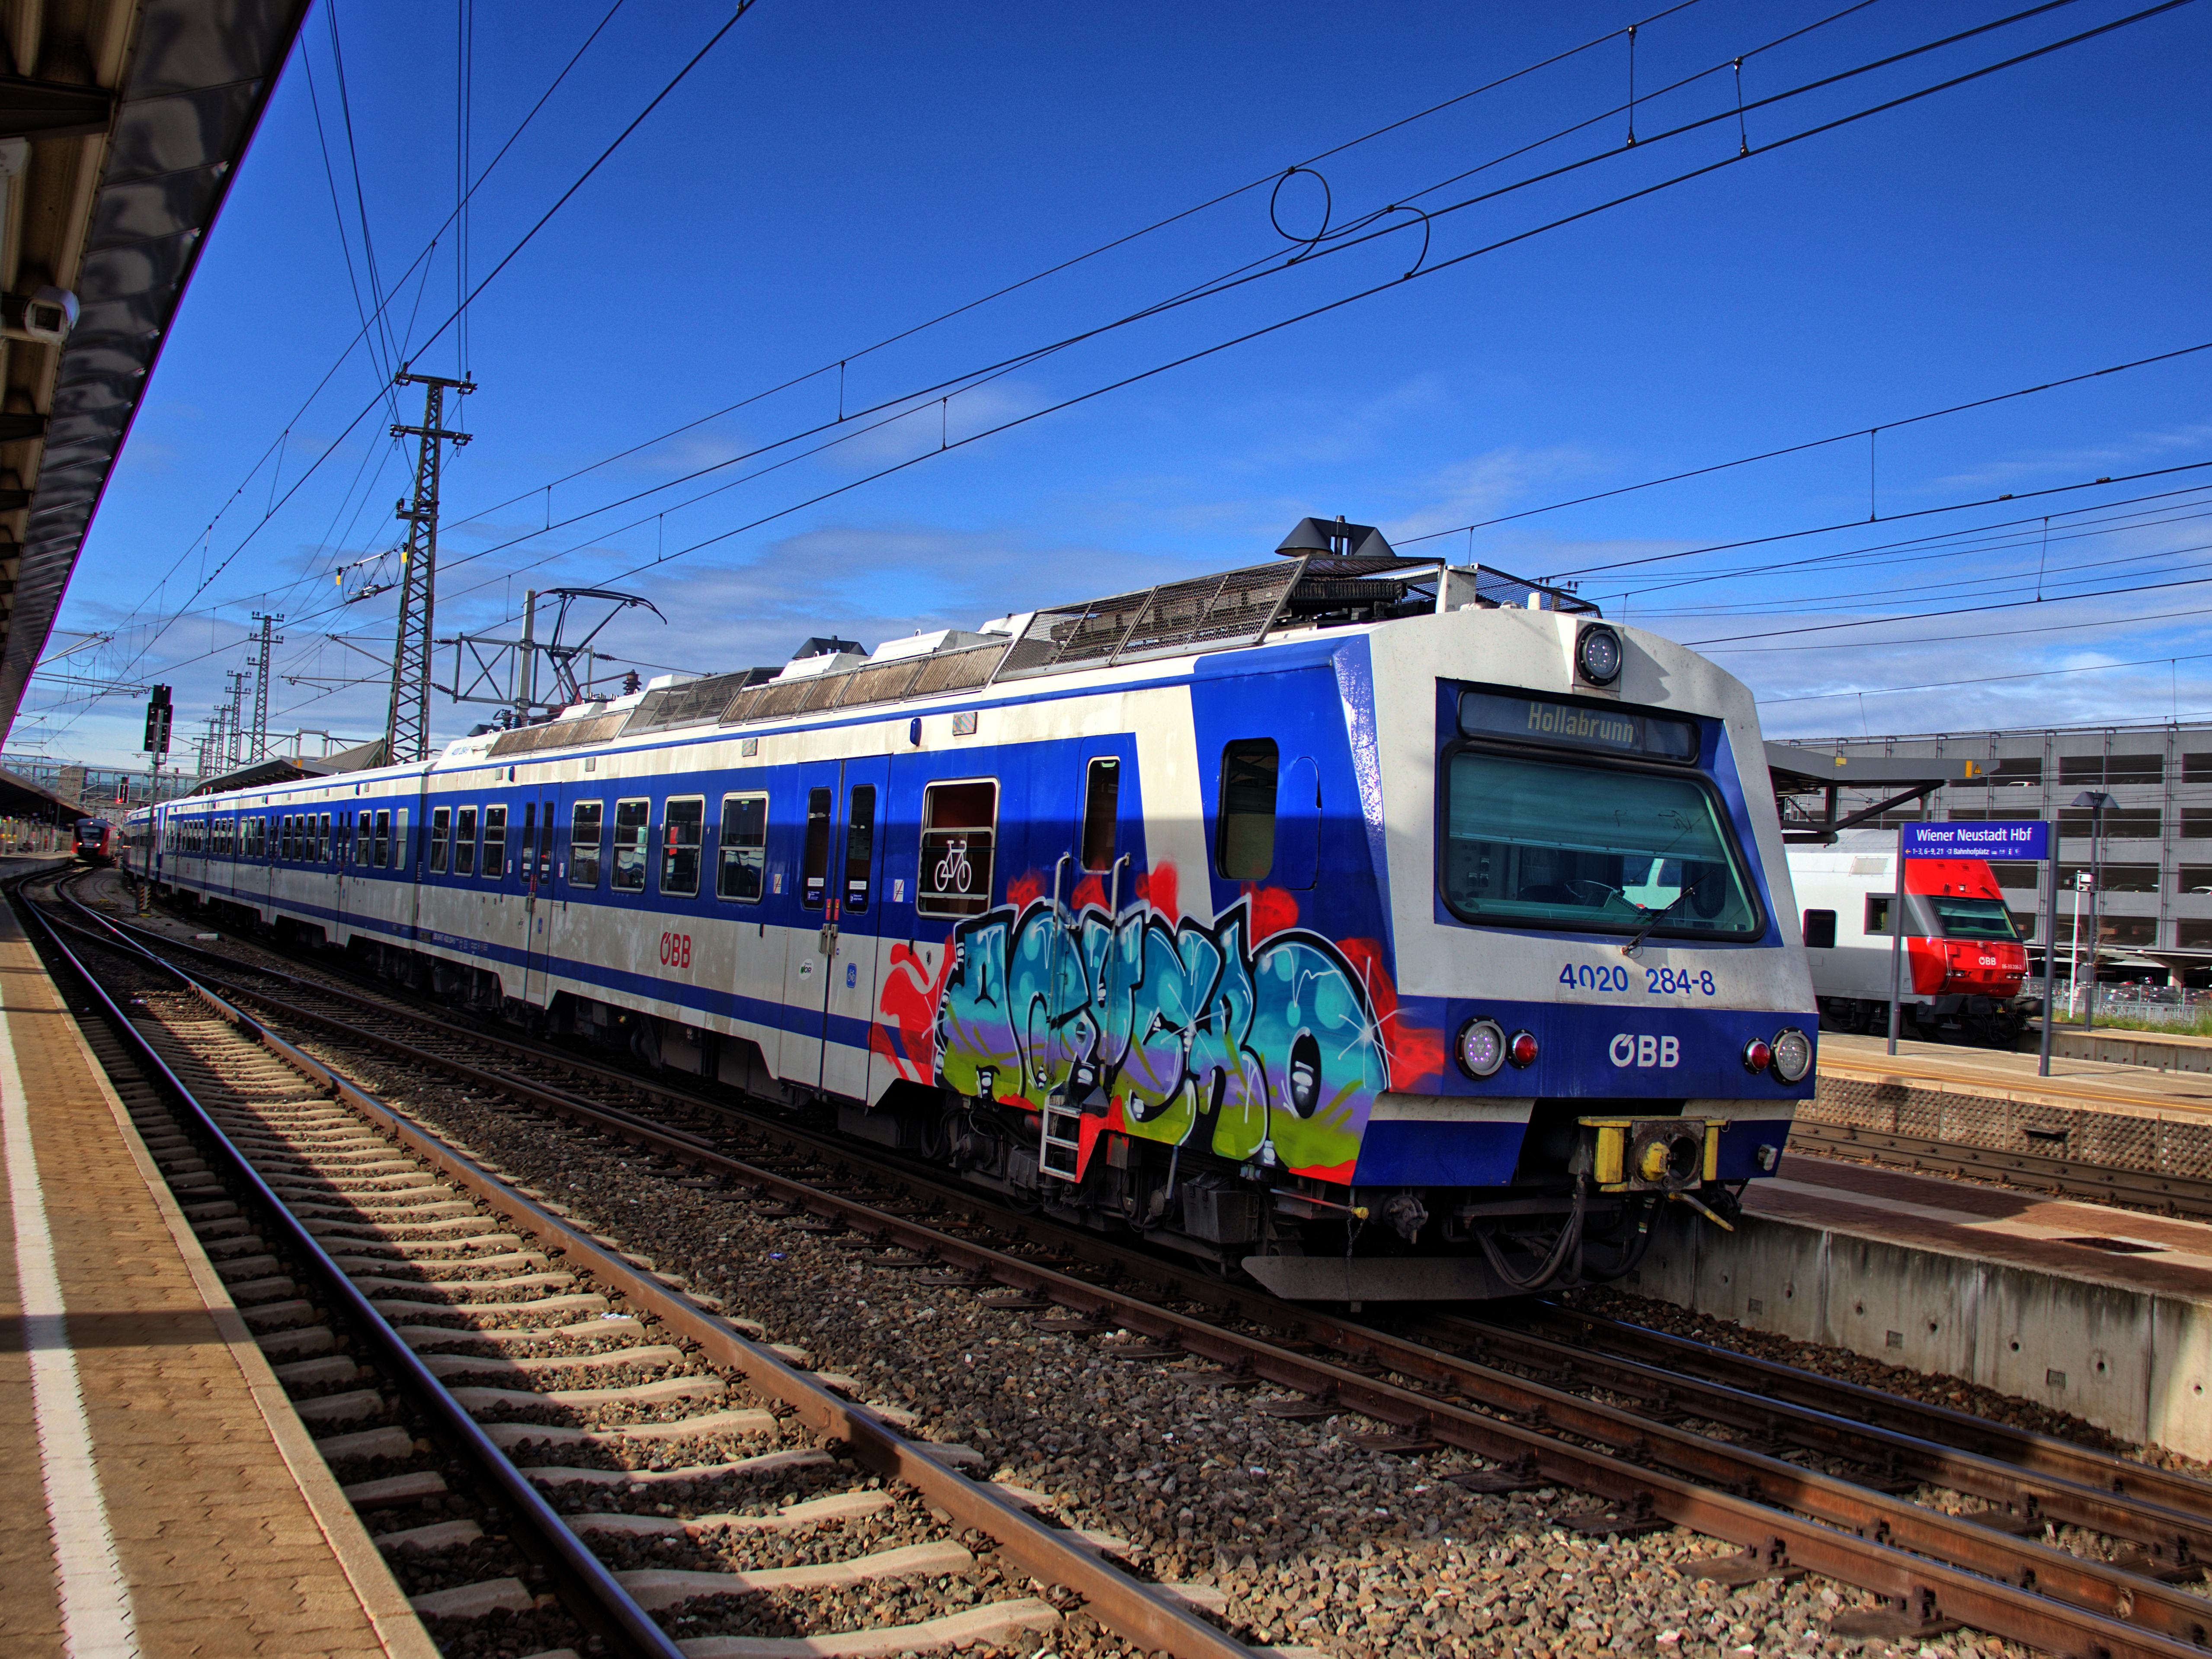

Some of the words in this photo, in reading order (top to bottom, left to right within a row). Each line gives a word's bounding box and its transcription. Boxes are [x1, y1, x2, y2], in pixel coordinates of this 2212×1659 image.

[1528, 702, 1633, 743] Hollabrunn
[1917, 829, 1954, 841] Wiener
[1957, 828, 2007, 841] Neustadt
[2010, 827, 2032, 841] Hbf
[1953, 848, 1990, 856] Bahnhofplatz
[660, 932, 691, 969] ÖBB
[1978, 956, 1996, 965] ÖBB
[801, 965, 812, 974] VOR
[1559, 964, 1628, 991] 4020
[1645, 968, 1716, 996] 284-8
[1609, 1034, 1680, 1067] ÖBB
